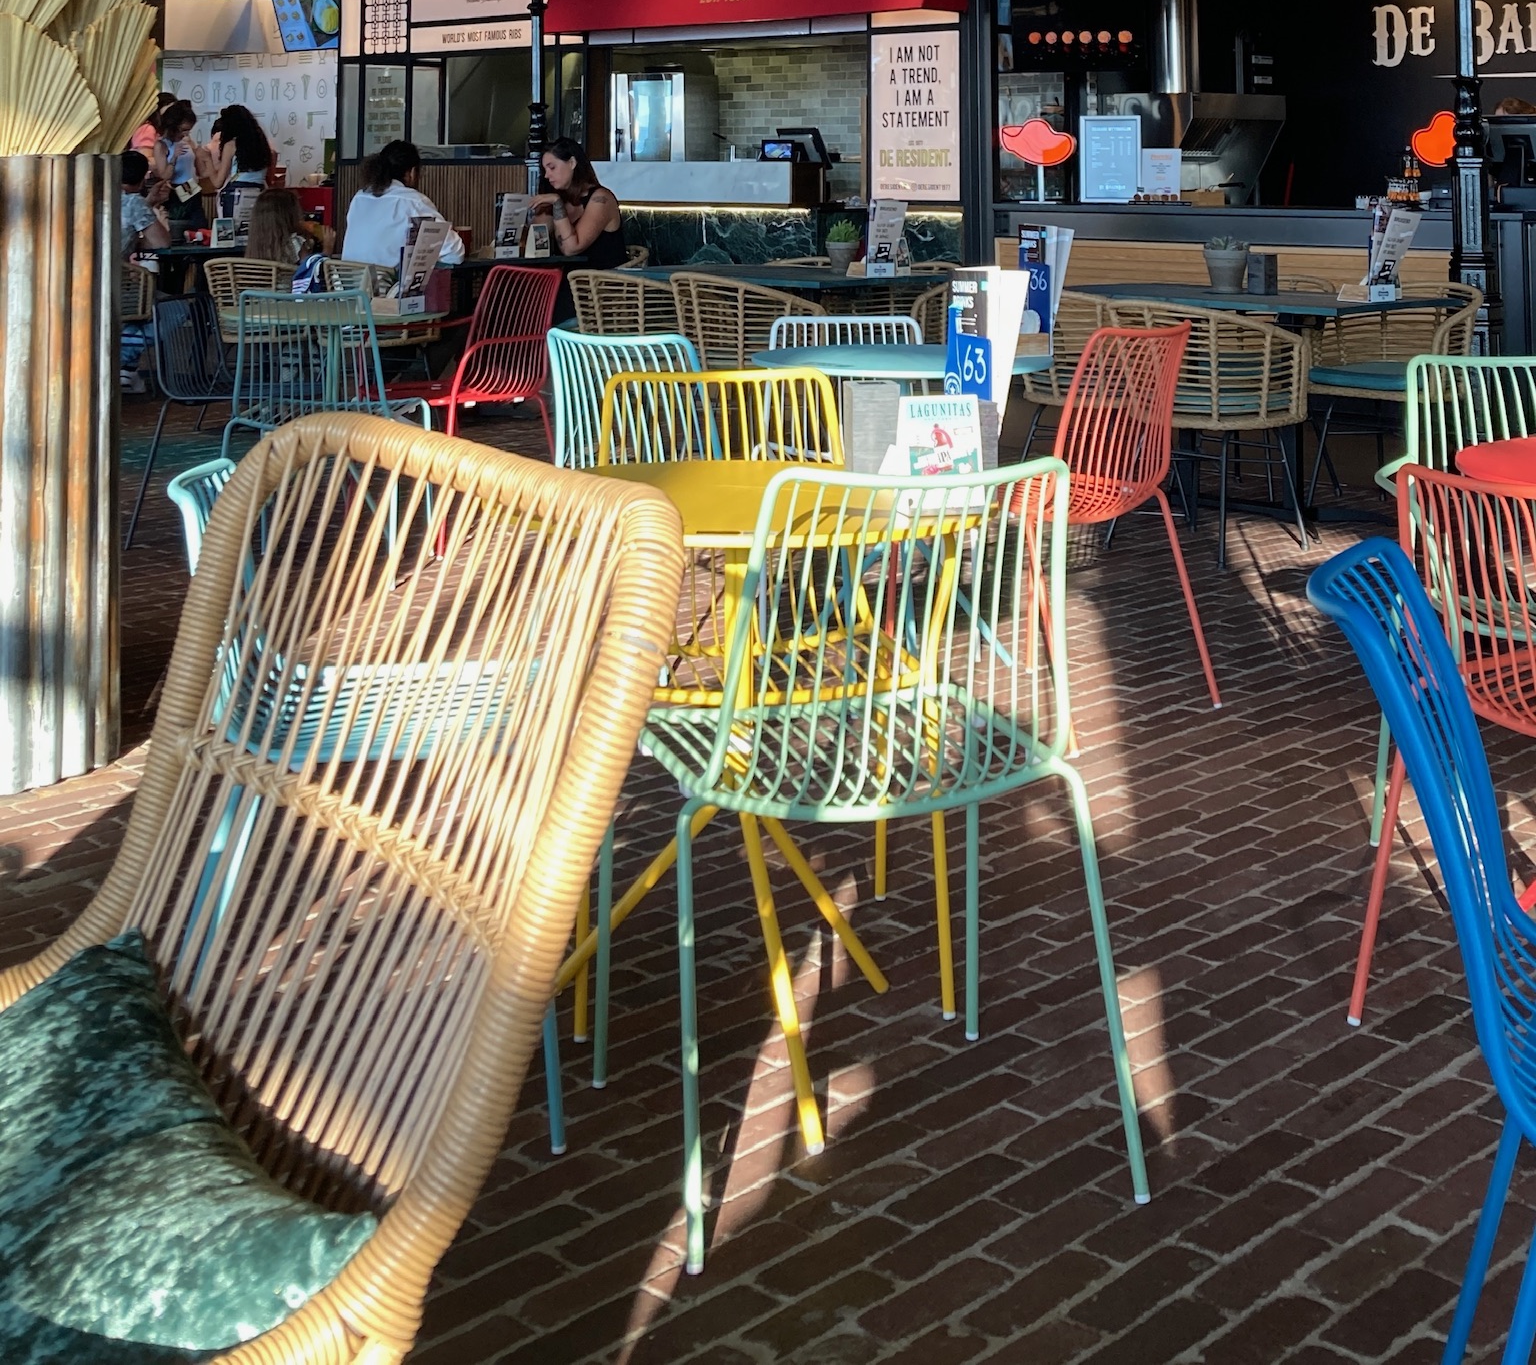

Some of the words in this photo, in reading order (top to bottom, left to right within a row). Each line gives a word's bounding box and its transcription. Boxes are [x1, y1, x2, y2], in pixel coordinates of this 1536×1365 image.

[442, 32, 466, 44] WORLD'S
[467, 31, 482, 43] MOST
[484, 29, 507, 42] FAMOUS
[508, 28, 522, 40] RIBS
[1371, 4, 1436, 68] DE
[889, 47, 893, 64] I
[896, 46, 914, 63] AM
[918, 44, 940, 63] NOT
[889, 68, 896, 85] A
[902, 67, 941, 85] TREND,
[896, 90, 899, 107] I
[904, 89, 922, 106] AM
[927, 89, 934, 106] A
[882, 110, 950, 128] STATEMENT
[879, 149, 894, 168] DE
[952, 280, 978, 294] SUMMER
[1030, 268, 1048, 291] 36
[963, 344, 987, 385] 63
[910, 402, 972, 418] LAGUNITAS
